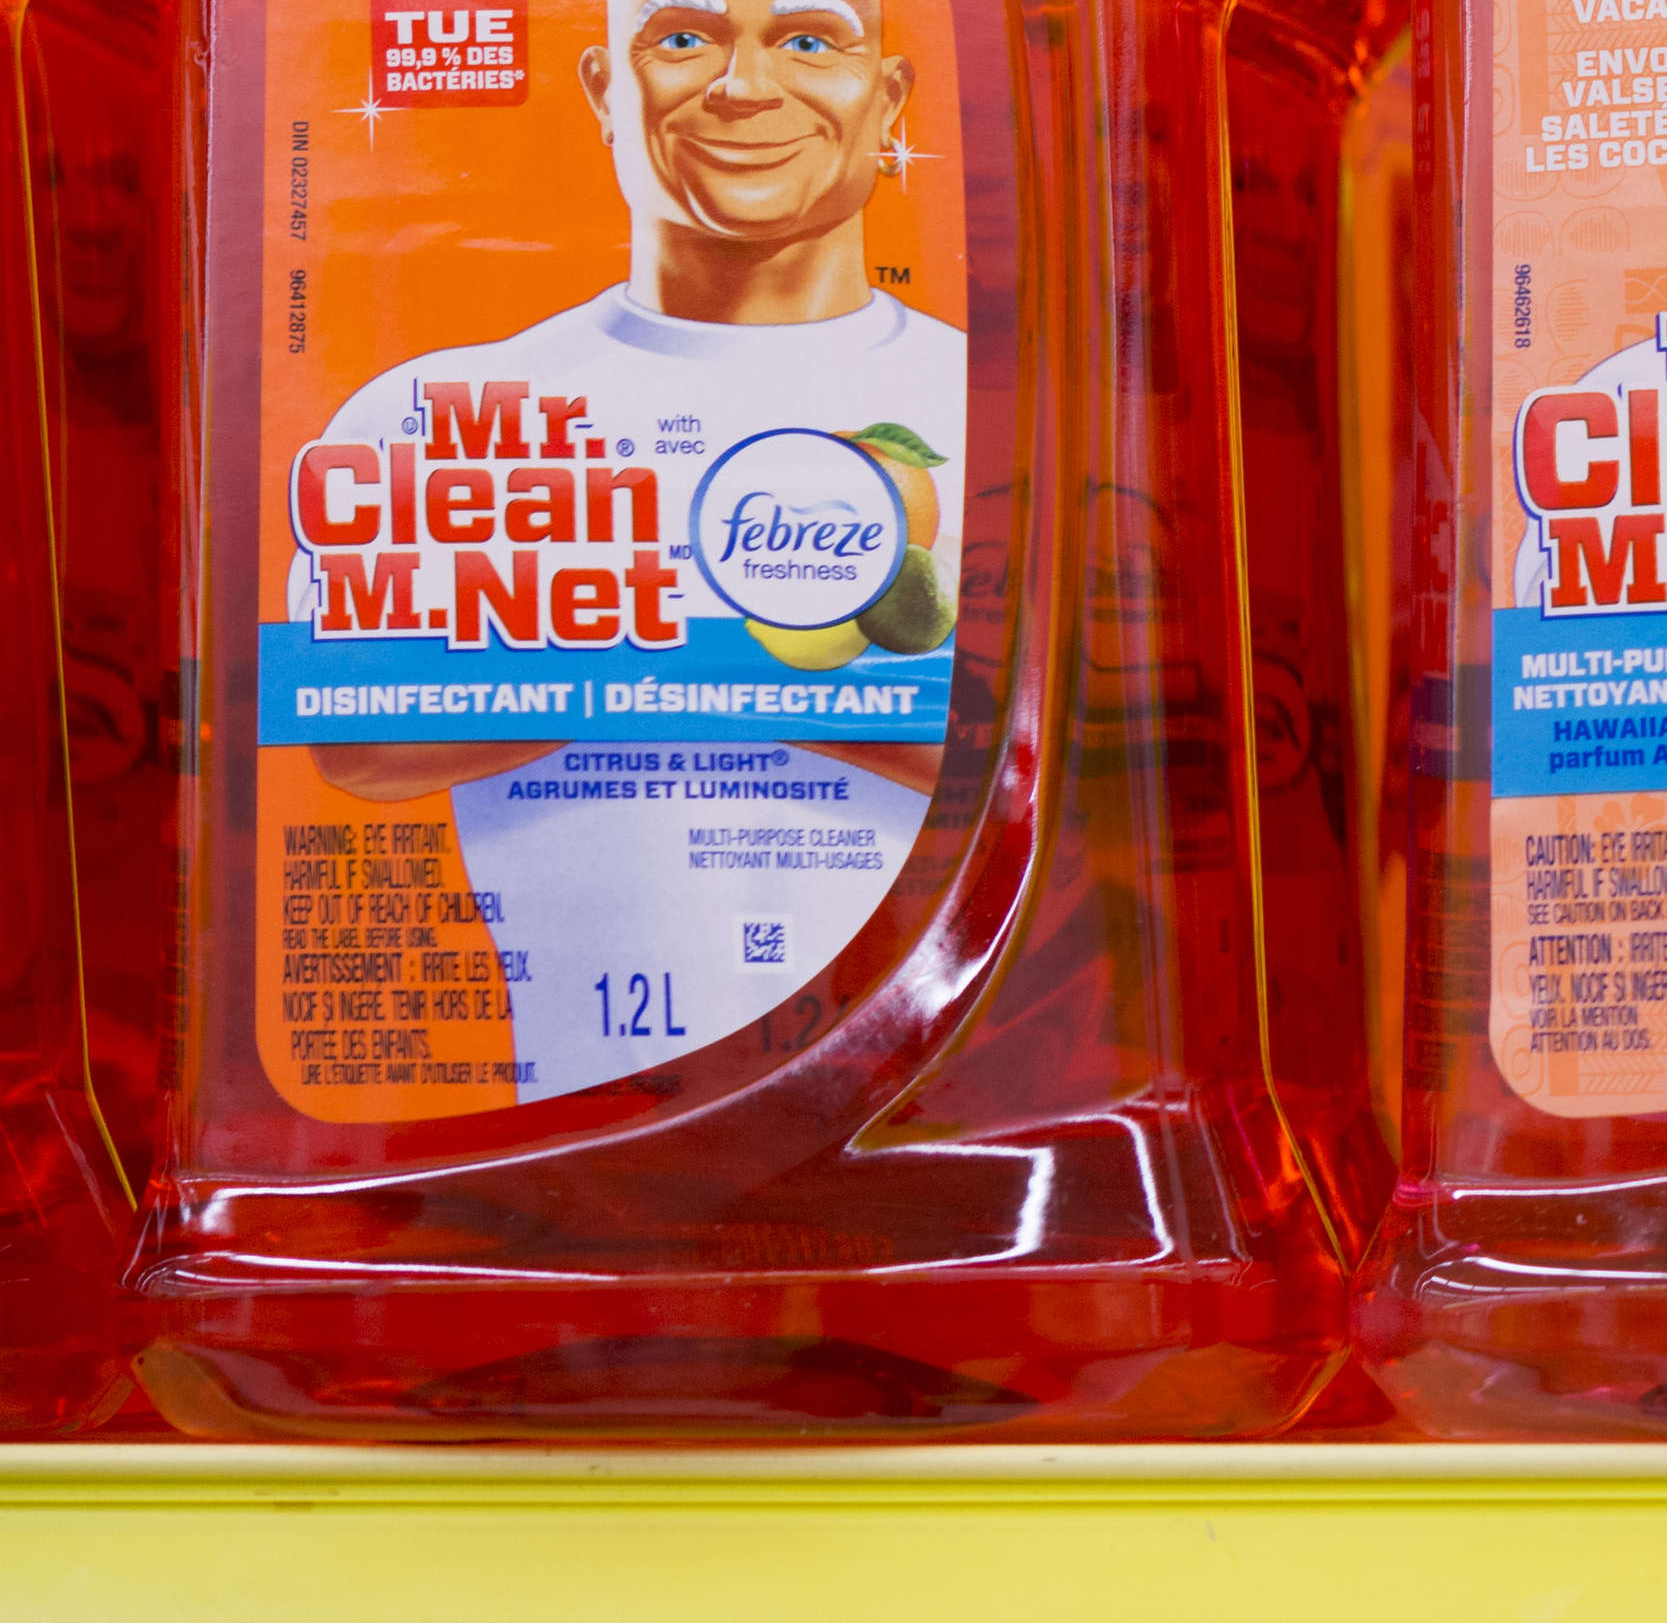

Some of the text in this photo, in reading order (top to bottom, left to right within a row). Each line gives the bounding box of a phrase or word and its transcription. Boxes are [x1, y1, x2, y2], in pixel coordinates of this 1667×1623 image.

[386, 9, 514, 43] TUE
[466, 46, 514, 66] DES
[1525, 144, 1588, 172] LES
[289, 120, 310, 354] DIN 02327457 96412875
[1514, 264, 1531, 349] 96462618
[424, 380, 606, 460] Mr.
[657, 415, 701, 433] with
[655, 438, 705, 456] avec
[297, 443, 659, 547] Clean
[720, 491, 885, 563] febreze
[743, 559, 858, 582] freshness
[296, 676, 918, 717] DISINFECTANT DÉSINFECTANT
[563, 751, 661, 773] CITRUS
[668, 753, 686, 772] &
[1549, 743, 1648, 775] parfum
[507, 775, 849, 801] AGRUMES ET LUMINOSITÉ
[689, 827, 876, 848] MULTI-PURPOSE CLEANER
[689, 851, 883, 870] NETTOYANT MULTI-USAGES
[594, 972, 686, 1037] 1.2 L
